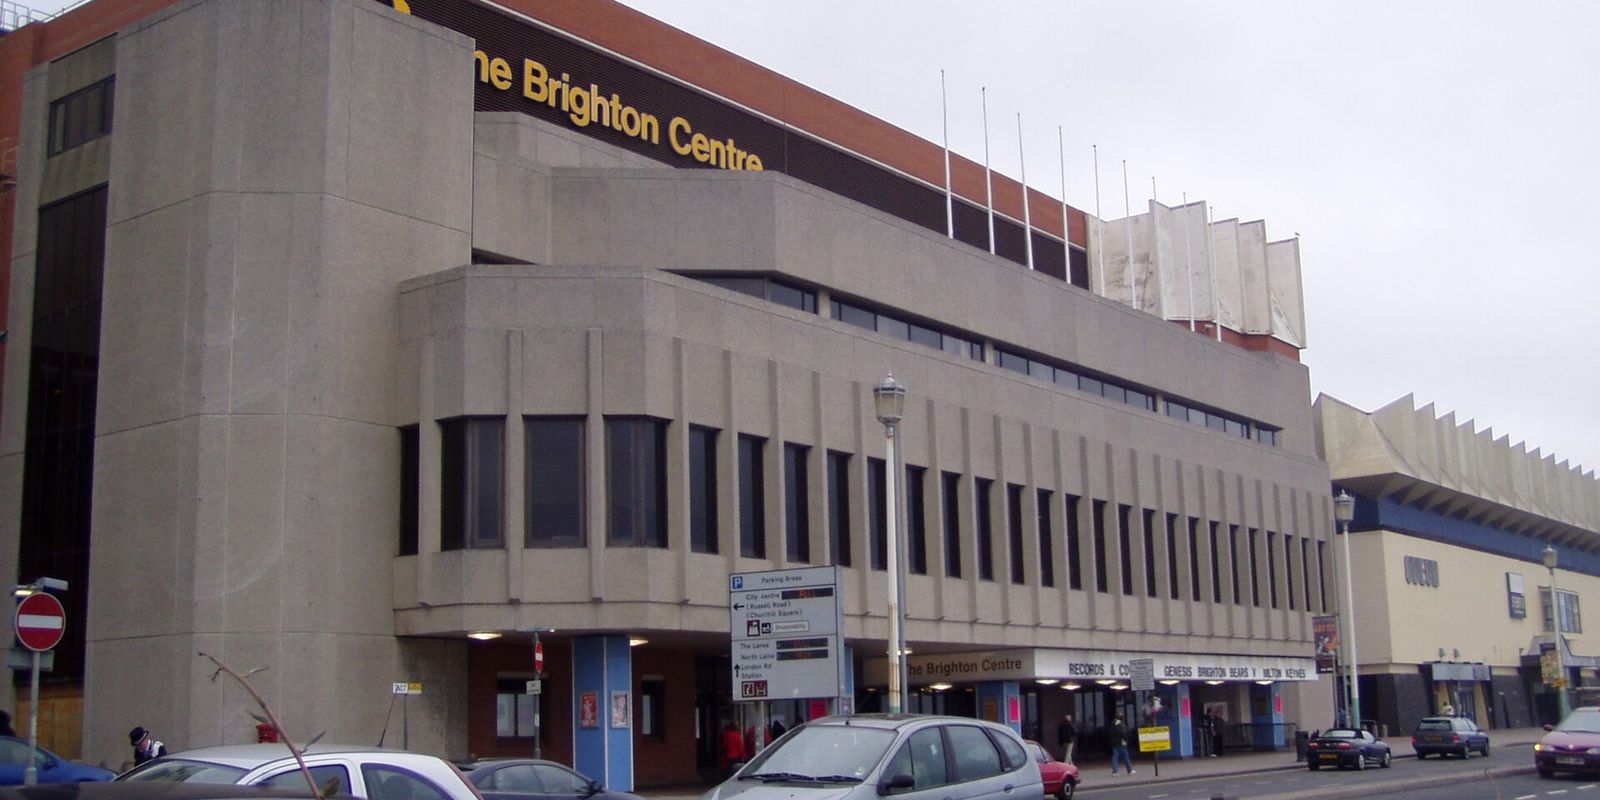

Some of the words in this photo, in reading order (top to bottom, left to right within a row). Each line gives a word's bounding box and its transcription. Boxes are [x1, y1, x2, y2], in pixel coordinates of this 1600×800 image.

[474, 50, 512, 91] he
[523, 57, 659, 145] Brighton
[669, 116, 764, 171] Centre
[926, 661, 978, 676] Brighton
[981, 659, 1022, 671] Centre
[1068, 663, 1105, 676] RECORDS
[1110, 664, 1115, 676] &
[1164, 666, 1193, 677] GENESIS
[1197, 666, 1227, 678] BRIGHTON
[1229, 667, 1249, 678] BEARS
